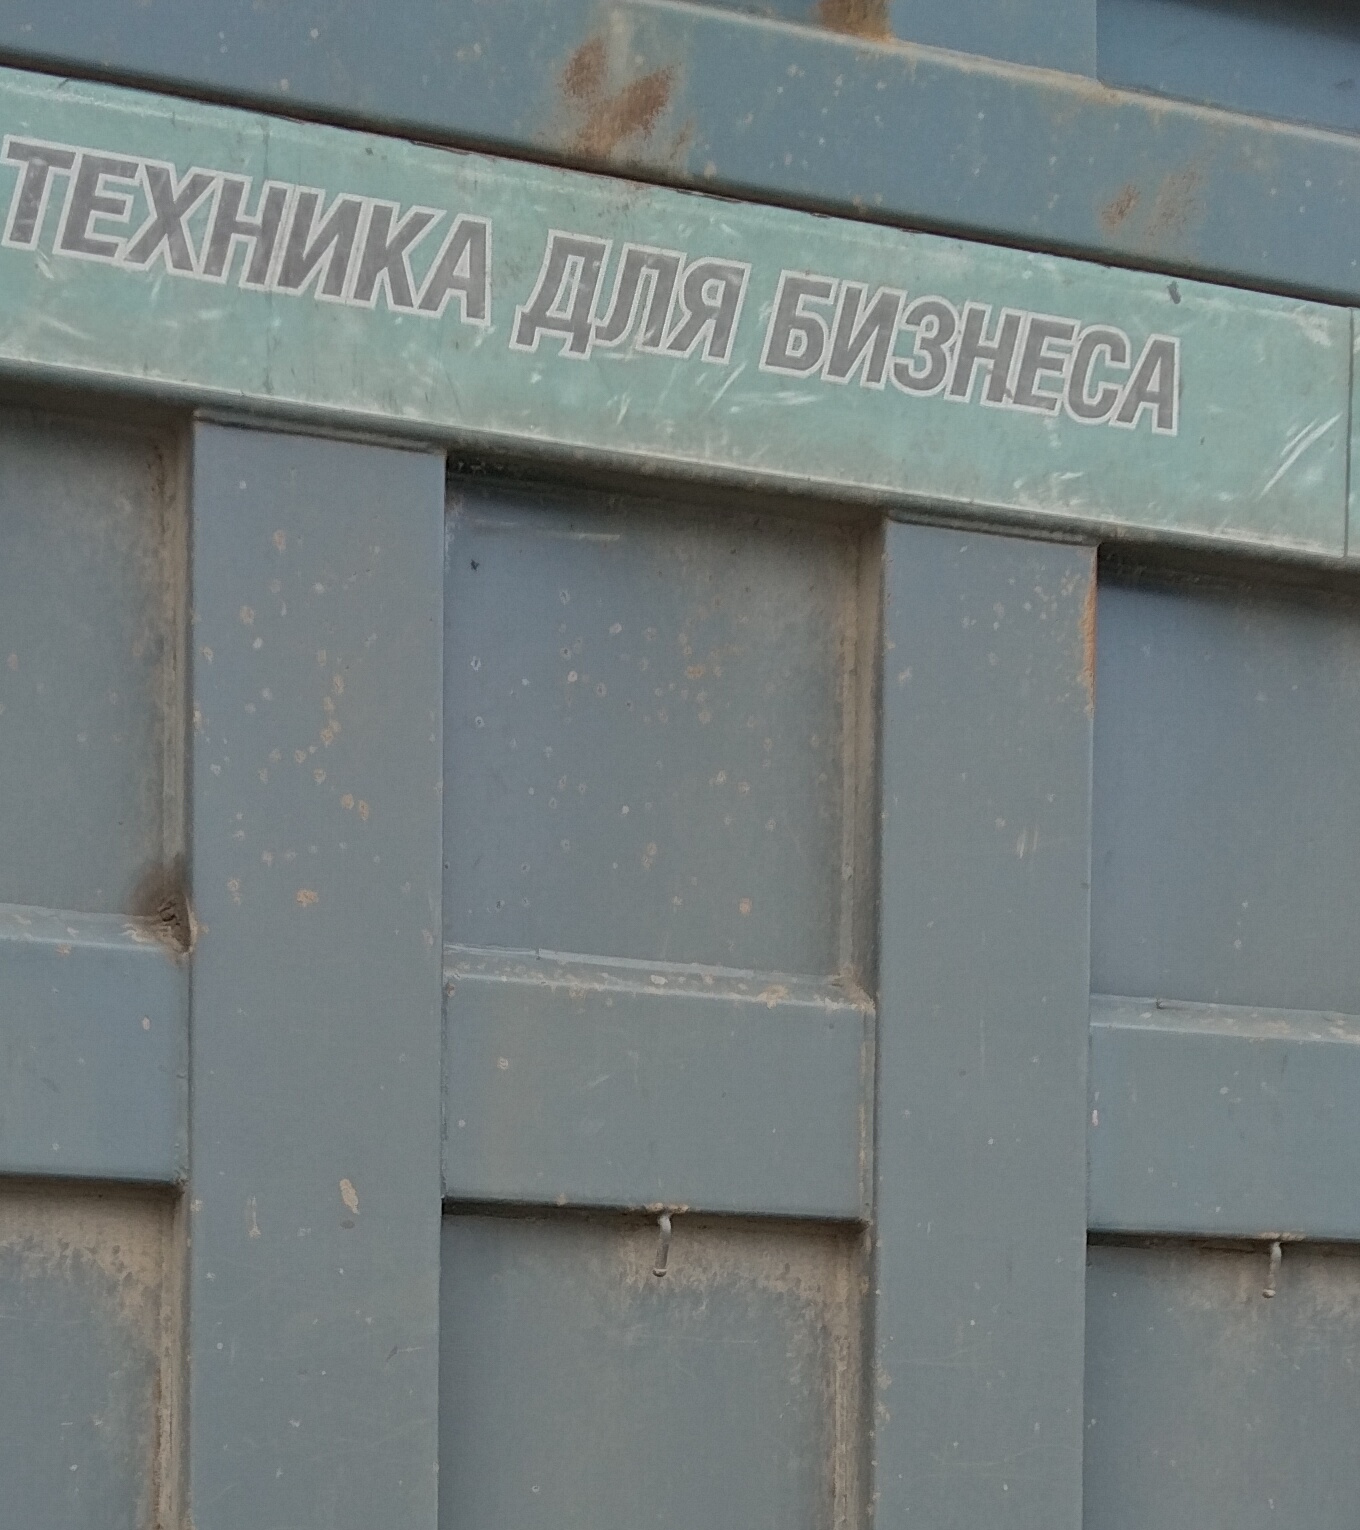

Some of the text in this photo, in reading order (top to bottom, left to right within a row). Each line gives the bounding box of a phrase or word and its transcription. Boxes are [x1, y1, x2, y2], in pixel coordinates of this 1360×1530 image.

[0, 135, 491, 325] ТЕХНИКА
[510, 229, 751, 364] ДЛЯ
[759, 269, 1181, 436] БИЗНЕСА
